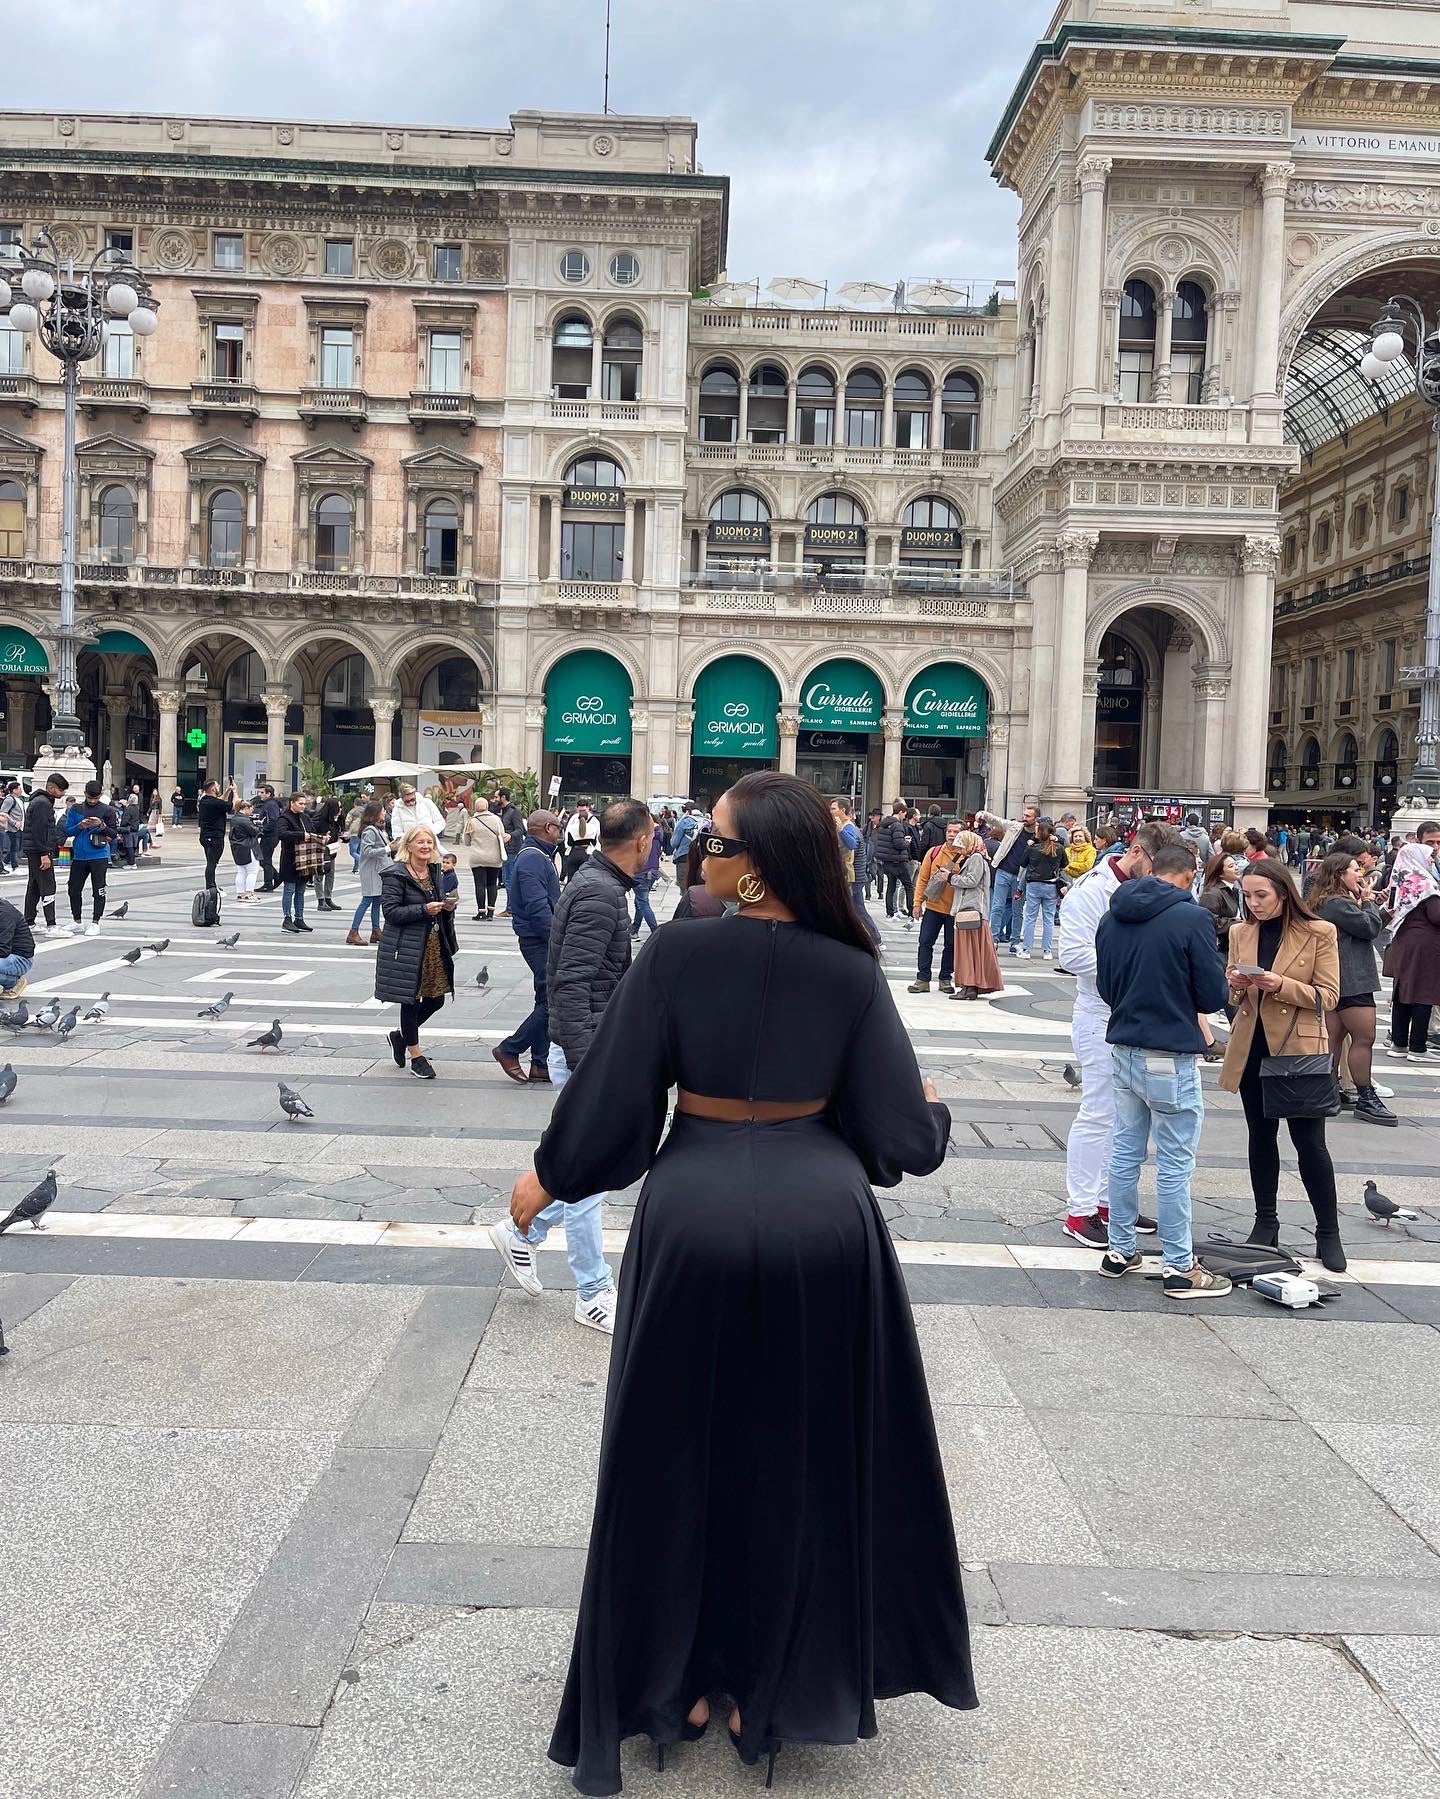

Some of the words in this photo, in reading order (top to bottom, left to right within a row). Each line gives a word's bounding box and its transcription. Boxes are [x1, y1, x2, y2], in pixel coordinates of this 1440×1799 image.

[1298, 135, 1307, 146] A
[1316, 135, 1380, 149] VITTORIO
[570, 490, 607, 501] DUOMO
[609, 492, 619, 502] 21
[715, 526, 750, 536] DUOMO
[752, 527, 763, 537] 21
[811, 529, 846, 539] DUOMO
[848, 530, 858, 540] 21
[906, 531, 942, 542] DUOMO
[943, 532, 954, 542] 21
[0, 664, 22, 672] ORIA
[24, 665, 48, 673] ROSSI
[806, 683, 874, 711] Currado
[912, 688, 978, 716] Currado
[834, 706, 873, 714] GIOIELLERIE
[561, 712, 617, 725] GRIMOLDI
[707, 720, 764, 735] GRIMOLDI
